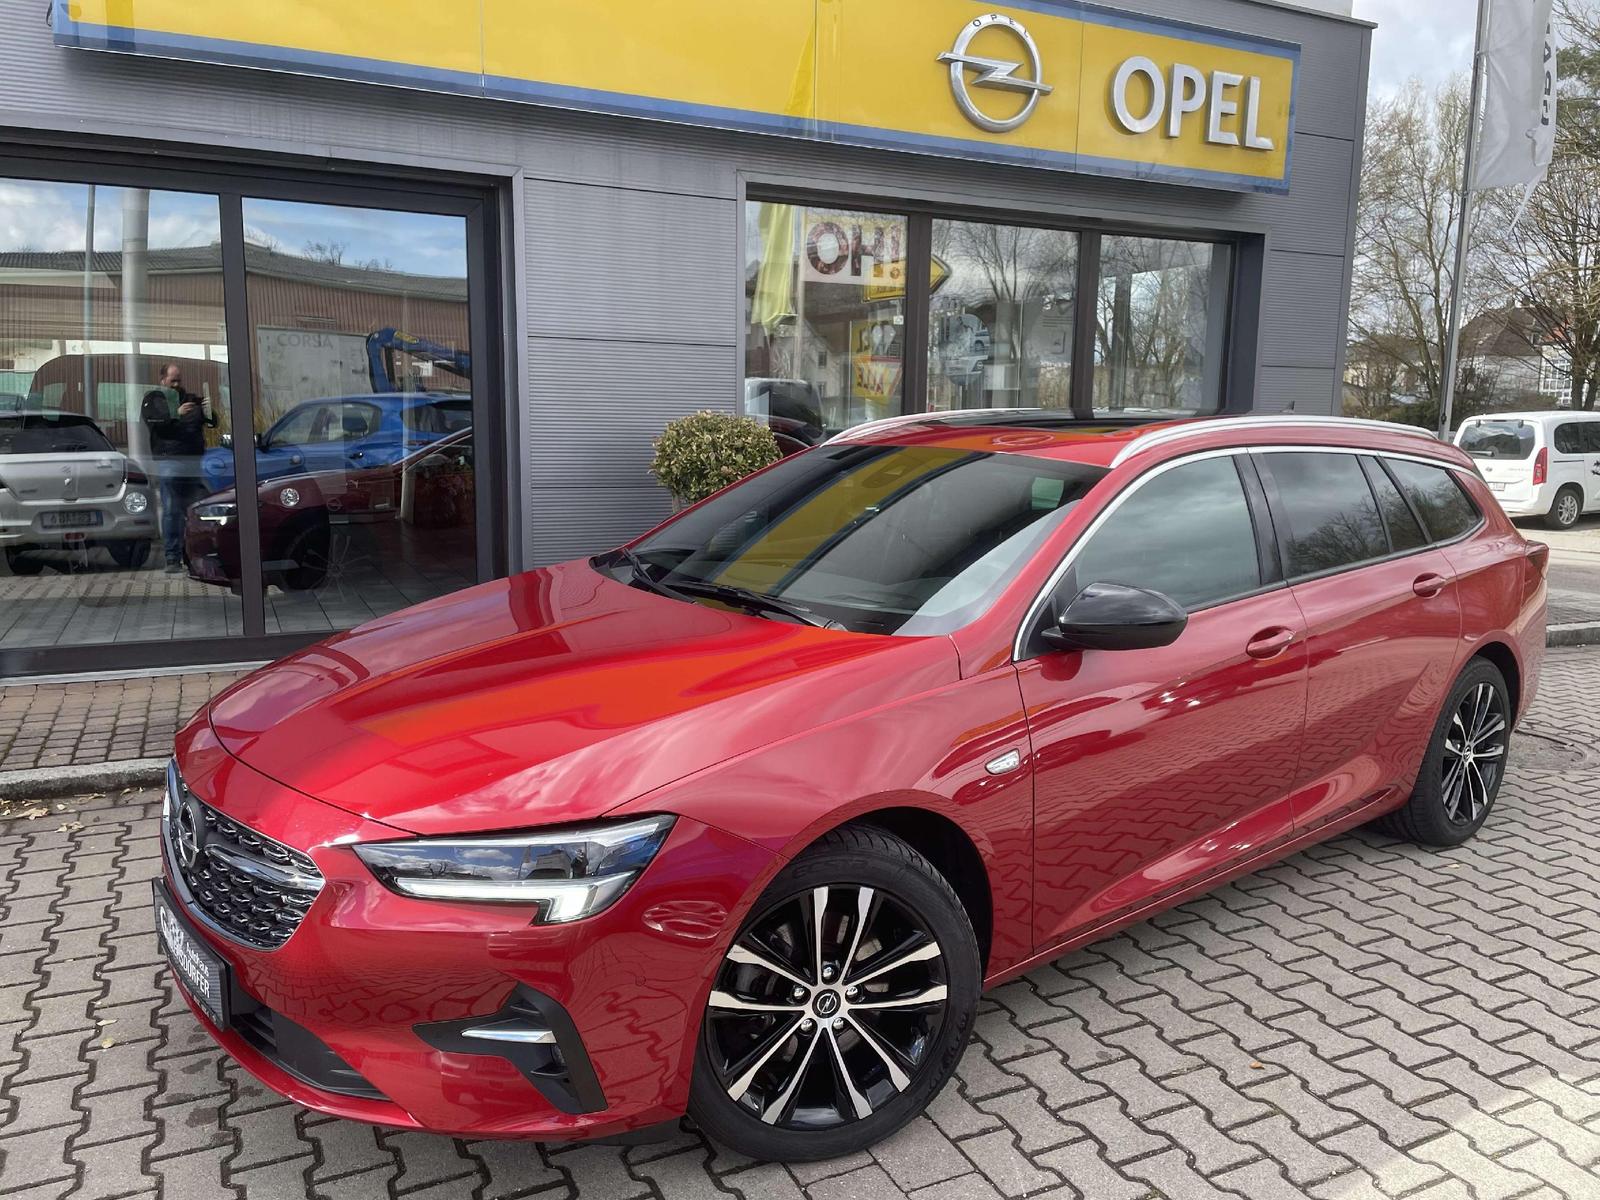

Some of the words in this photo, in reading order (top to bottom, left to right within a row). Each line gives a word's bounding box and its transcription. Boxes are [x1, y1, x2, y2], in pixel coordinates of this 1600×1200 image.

[972, 14, 1028, 38] OPEL
[1112, 56, 1275, 151] OPEL
[806, 221, 900, 280] OH!
[277, 333, 334, 350] CORSA
